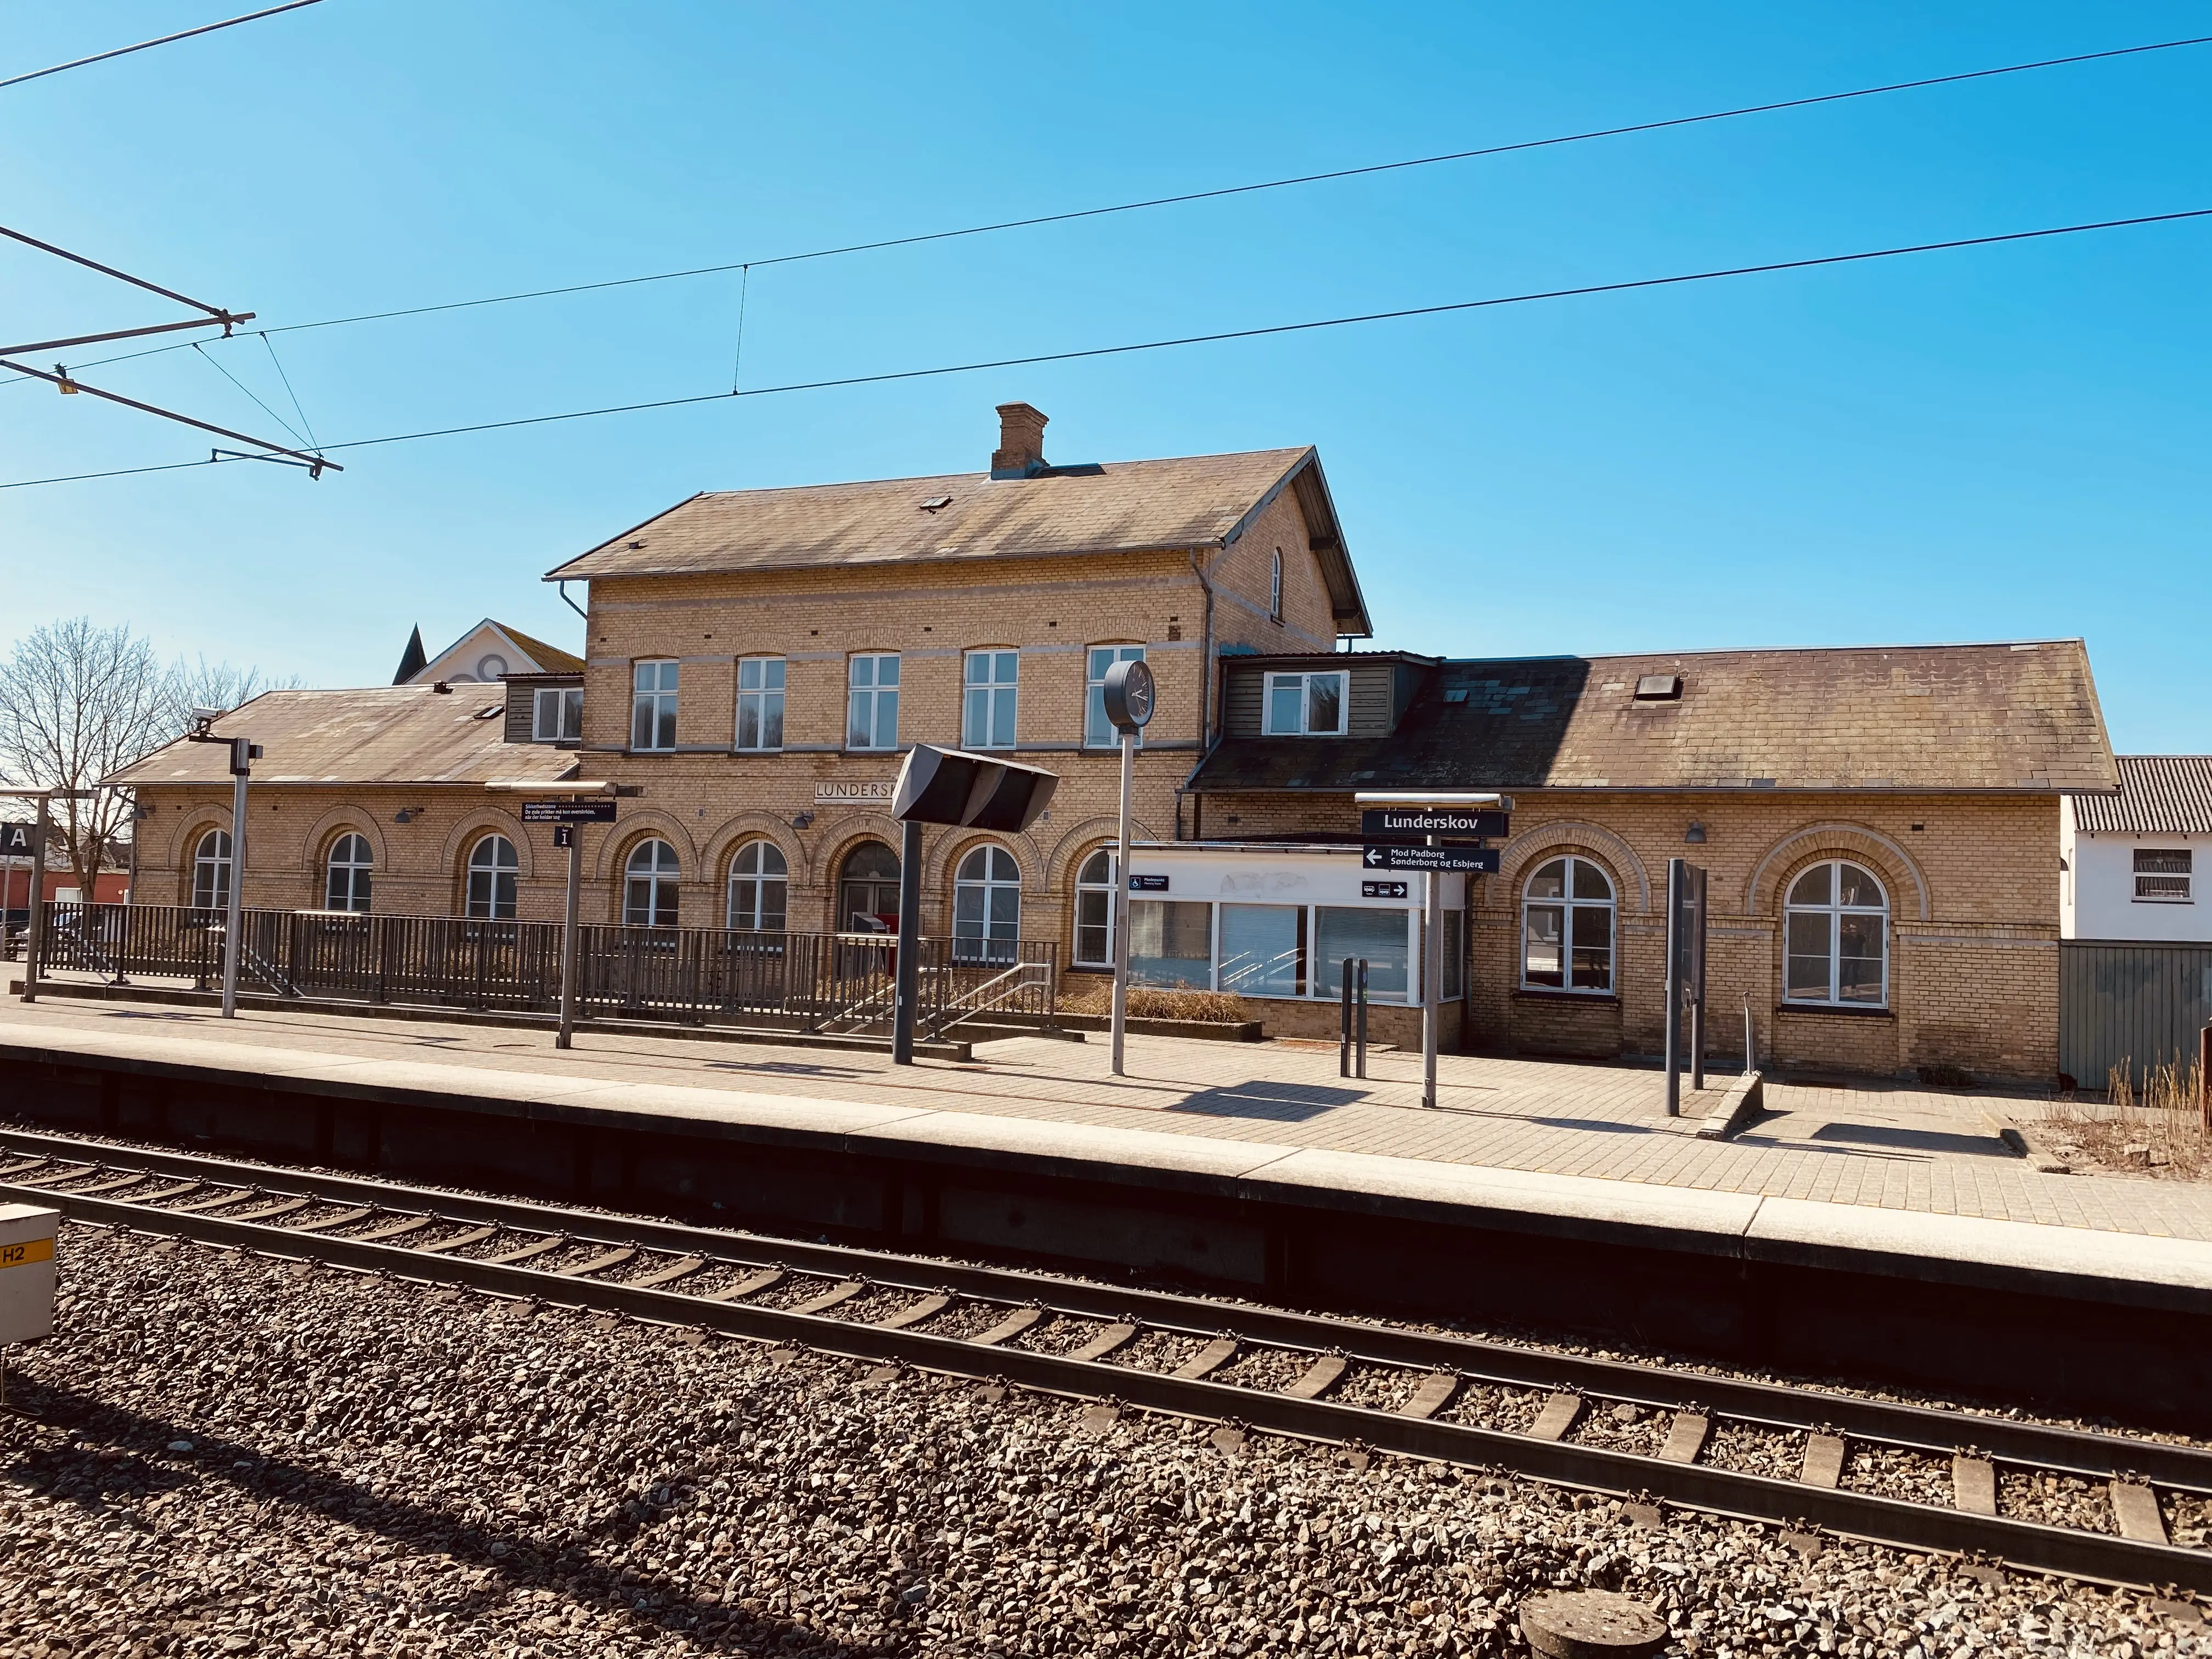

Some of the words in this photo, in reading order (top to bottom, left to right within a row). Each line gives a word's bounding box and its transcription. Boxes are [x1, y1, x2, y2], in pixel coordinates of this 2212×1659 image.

[1385, 815, 1478, 829] Lunderskov
[10, 828, 26, 847] A
[562, 833, 567, 844] 1
[1411, 850, 1444, 859] Padborg
[1391, 857, 1438, 867] Sønderborg
[1453, 860, 1483, 869] Esbjerg
[3, 1246, 25, 1263] H2
